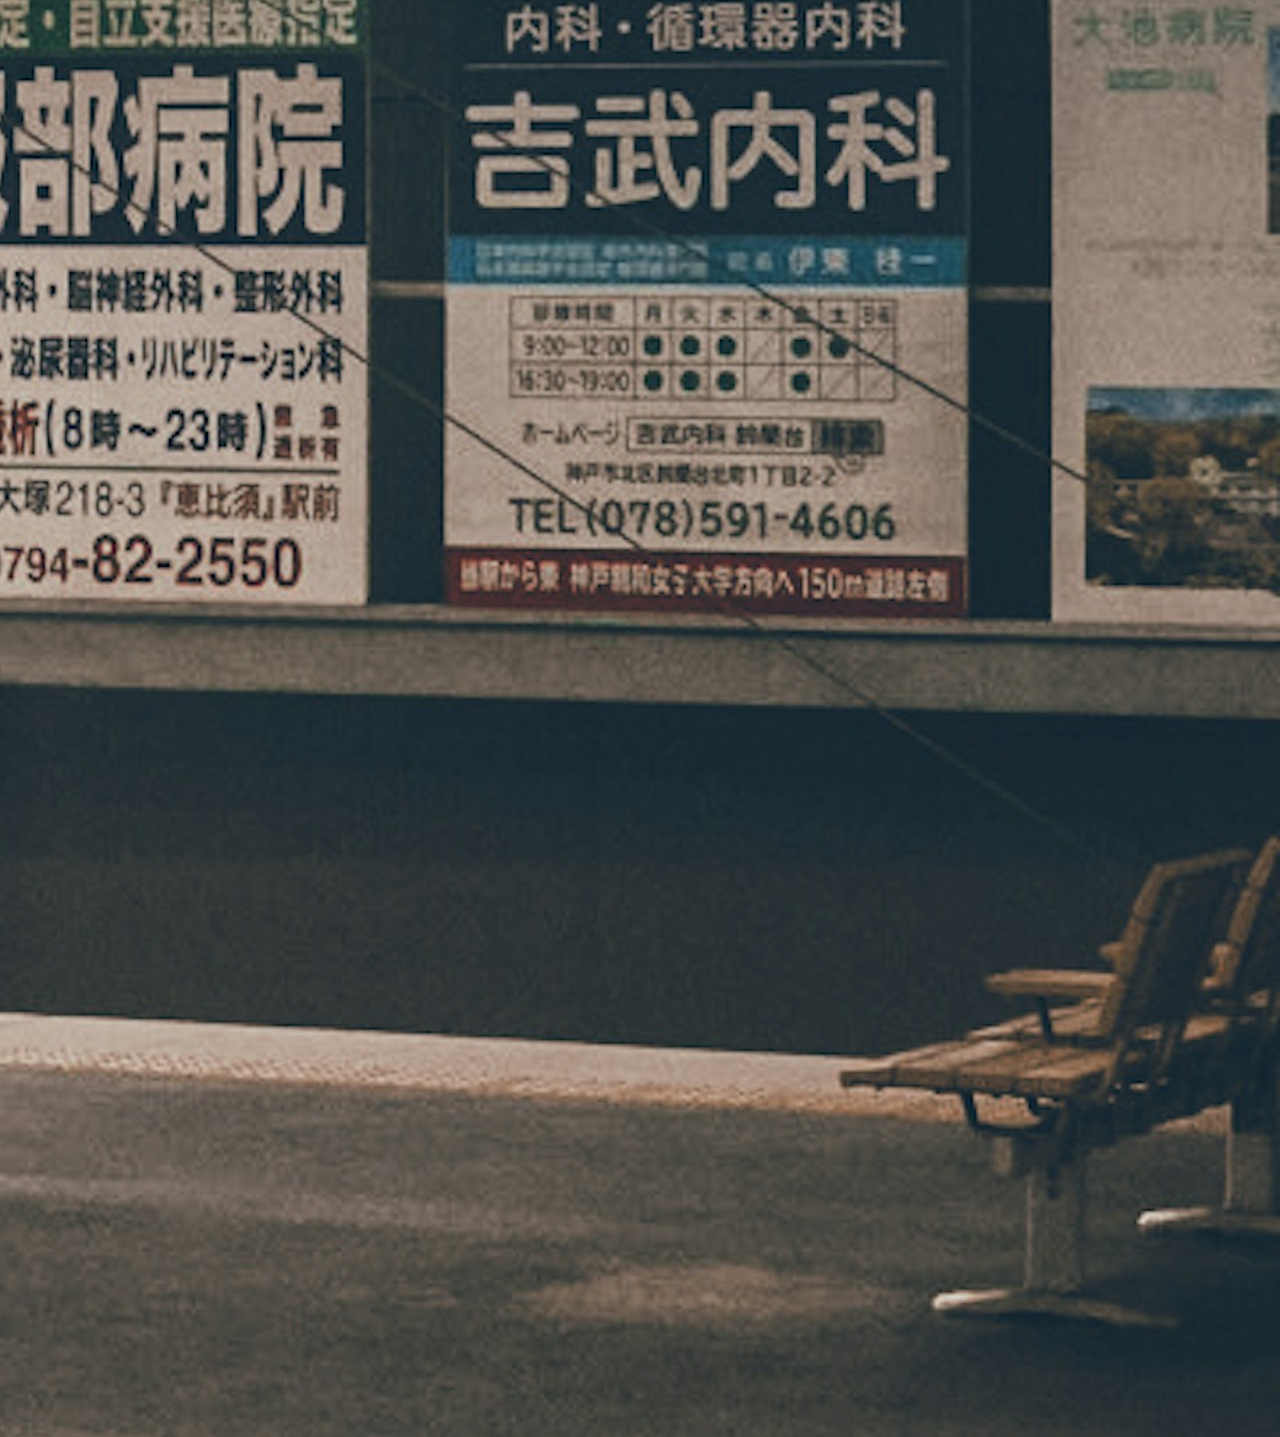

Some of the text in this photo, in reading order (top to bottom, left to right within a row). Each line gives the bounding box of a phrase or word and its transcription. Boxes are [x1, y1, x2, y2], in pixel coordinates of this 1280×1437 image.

[506, 0, 905, 54] 内科・循環器内科
[464, 88, 951, 213] 吉武内科
[643, 304, 662, 324] 月
[679, 305, 701, 324] 火
[716, 305, 737, 324] 水
[521, 422, 620, 446] ホームページ
[635, 424, 726, 447] 吉武内科
